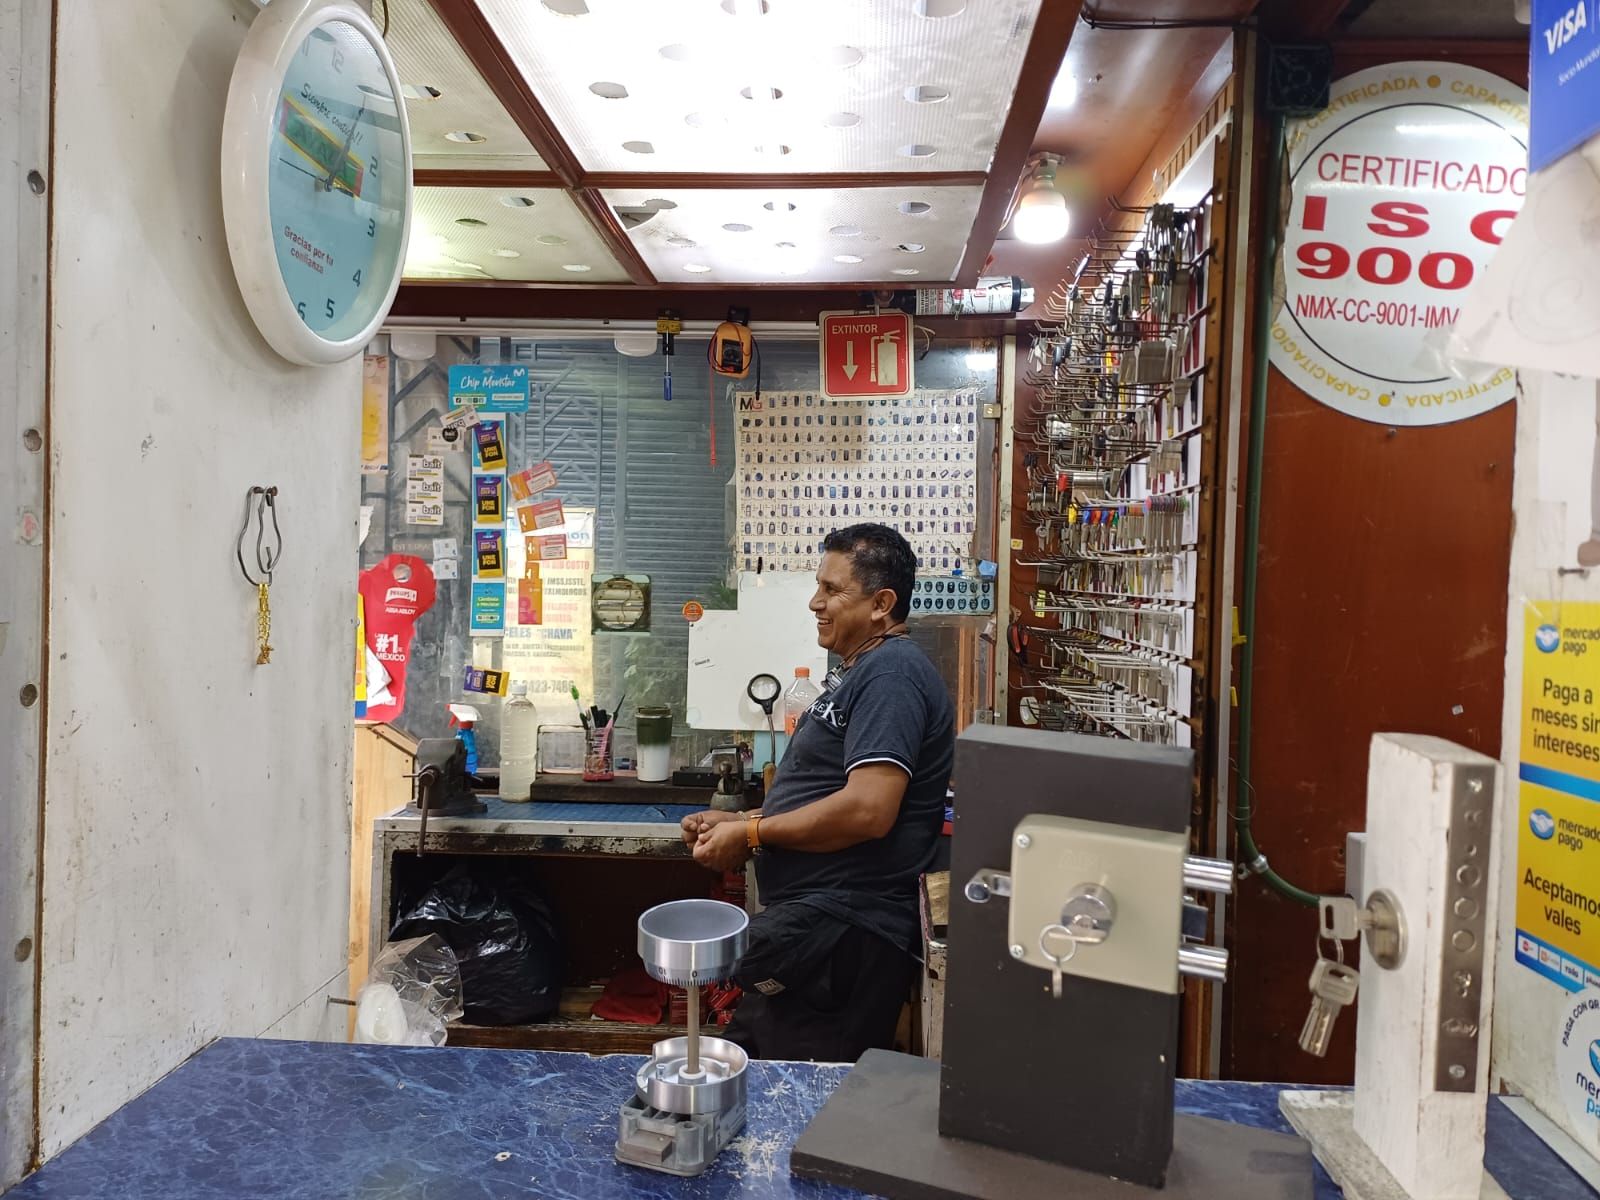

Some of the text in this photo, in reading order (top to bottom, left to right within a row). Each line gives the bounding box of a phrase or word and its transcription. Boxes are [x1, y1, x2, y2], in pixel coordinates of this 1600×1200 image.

[1544, 1, 1586, 55] VISA
[331, 47, 345, 74] 12
[1307, 77, 1420, 128] CERTIFICADA
[369, 156, 378, 178] 2
[1318, 152, 1526, 196] CERTIFICADO
[367, 218, 376, 238] 3
[284, 225, 334, 266] Gracias por tu
[290, 247, 324, 274] confianza
[352, 268, 362, 287] 4
[325, 298, 335, 319] 5
[831, 324, 878, 334] EXTINTOR
[460, 374, 516, 390] Chip Movistar
[422, 458, 442, 469] bait
[422, 482, 441, 492] bait
[422, 505, 441, 515] bait
[376, 633, 399, 653] #1
[1562, 641, 1587, 657] pago
[1543, 678, 1593, 706] Paga a
[1531, 707, 1578, 729] meses
[1533, 729, 1600, 762] intereses
[1558, 831, 1583, 851] pago
[1544, 904, 1581, 936] vales
[1562, 999, 1600, 1047] PAGA CON QR
